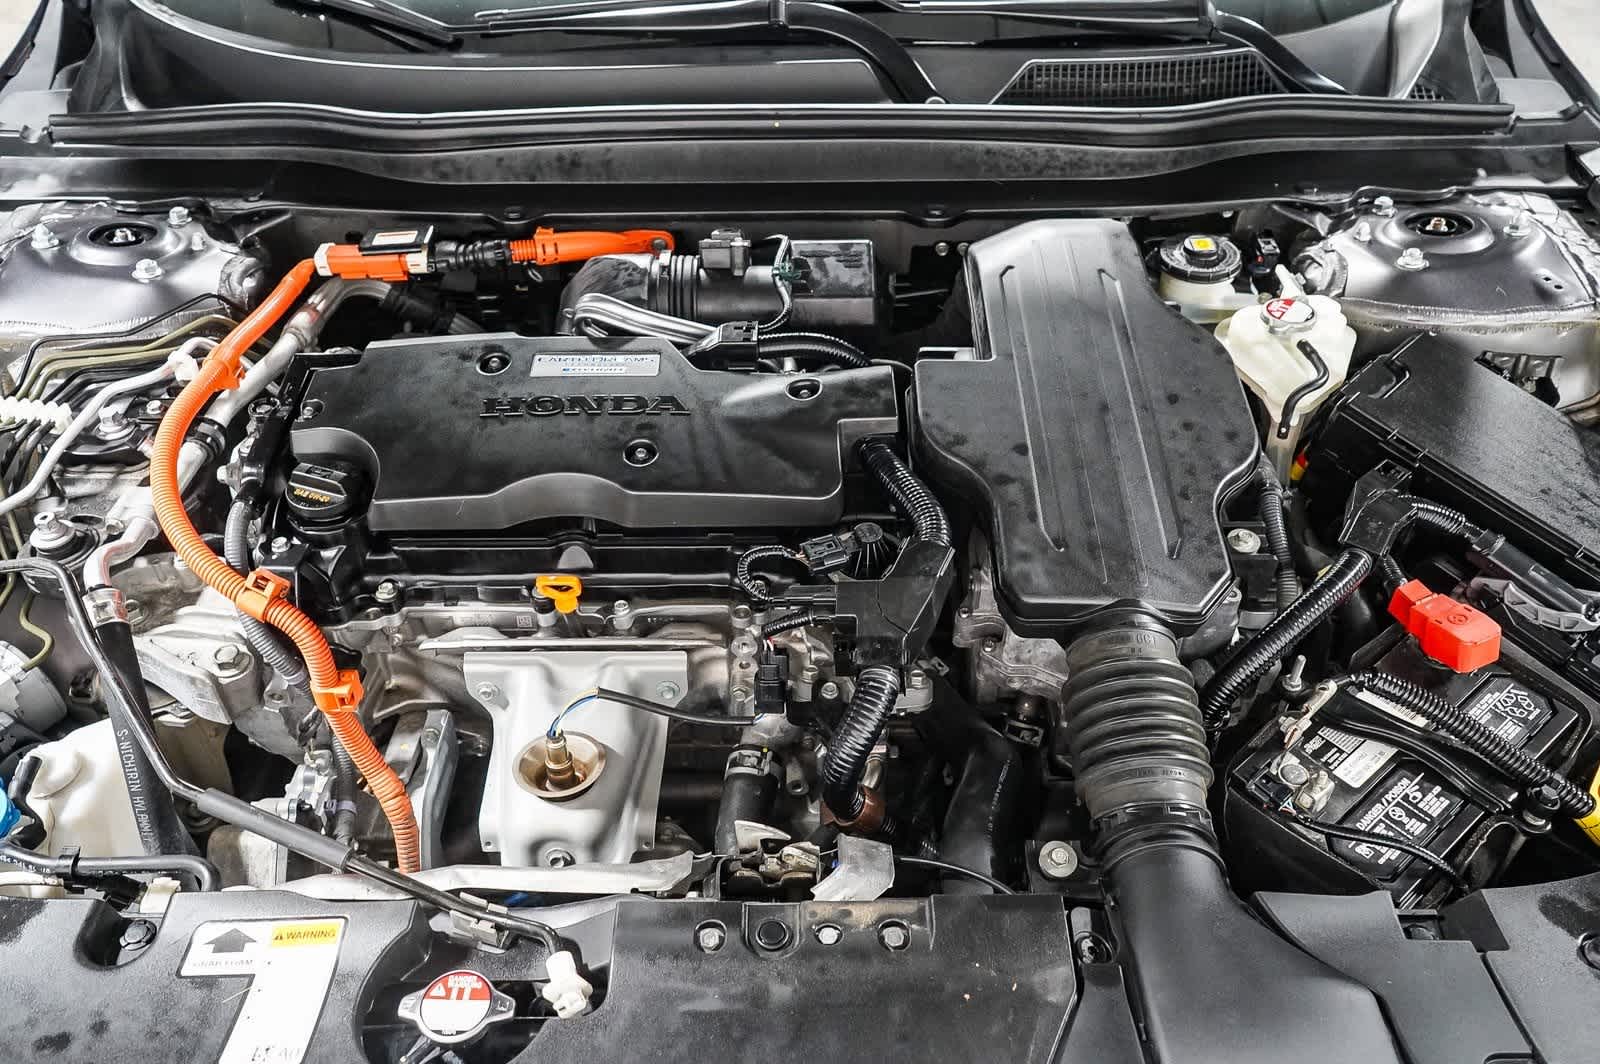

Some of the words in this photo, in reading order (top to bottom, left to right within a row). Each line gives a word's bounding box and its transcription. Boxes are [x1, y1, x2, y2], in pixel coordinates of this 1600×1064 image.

[480, 394, 691, 417] HONDA
[1355, 803, 1385, 831] DANGER
[1386, 777, 1412, 804] POISON
[286, 928, 337, 940] WARNING
